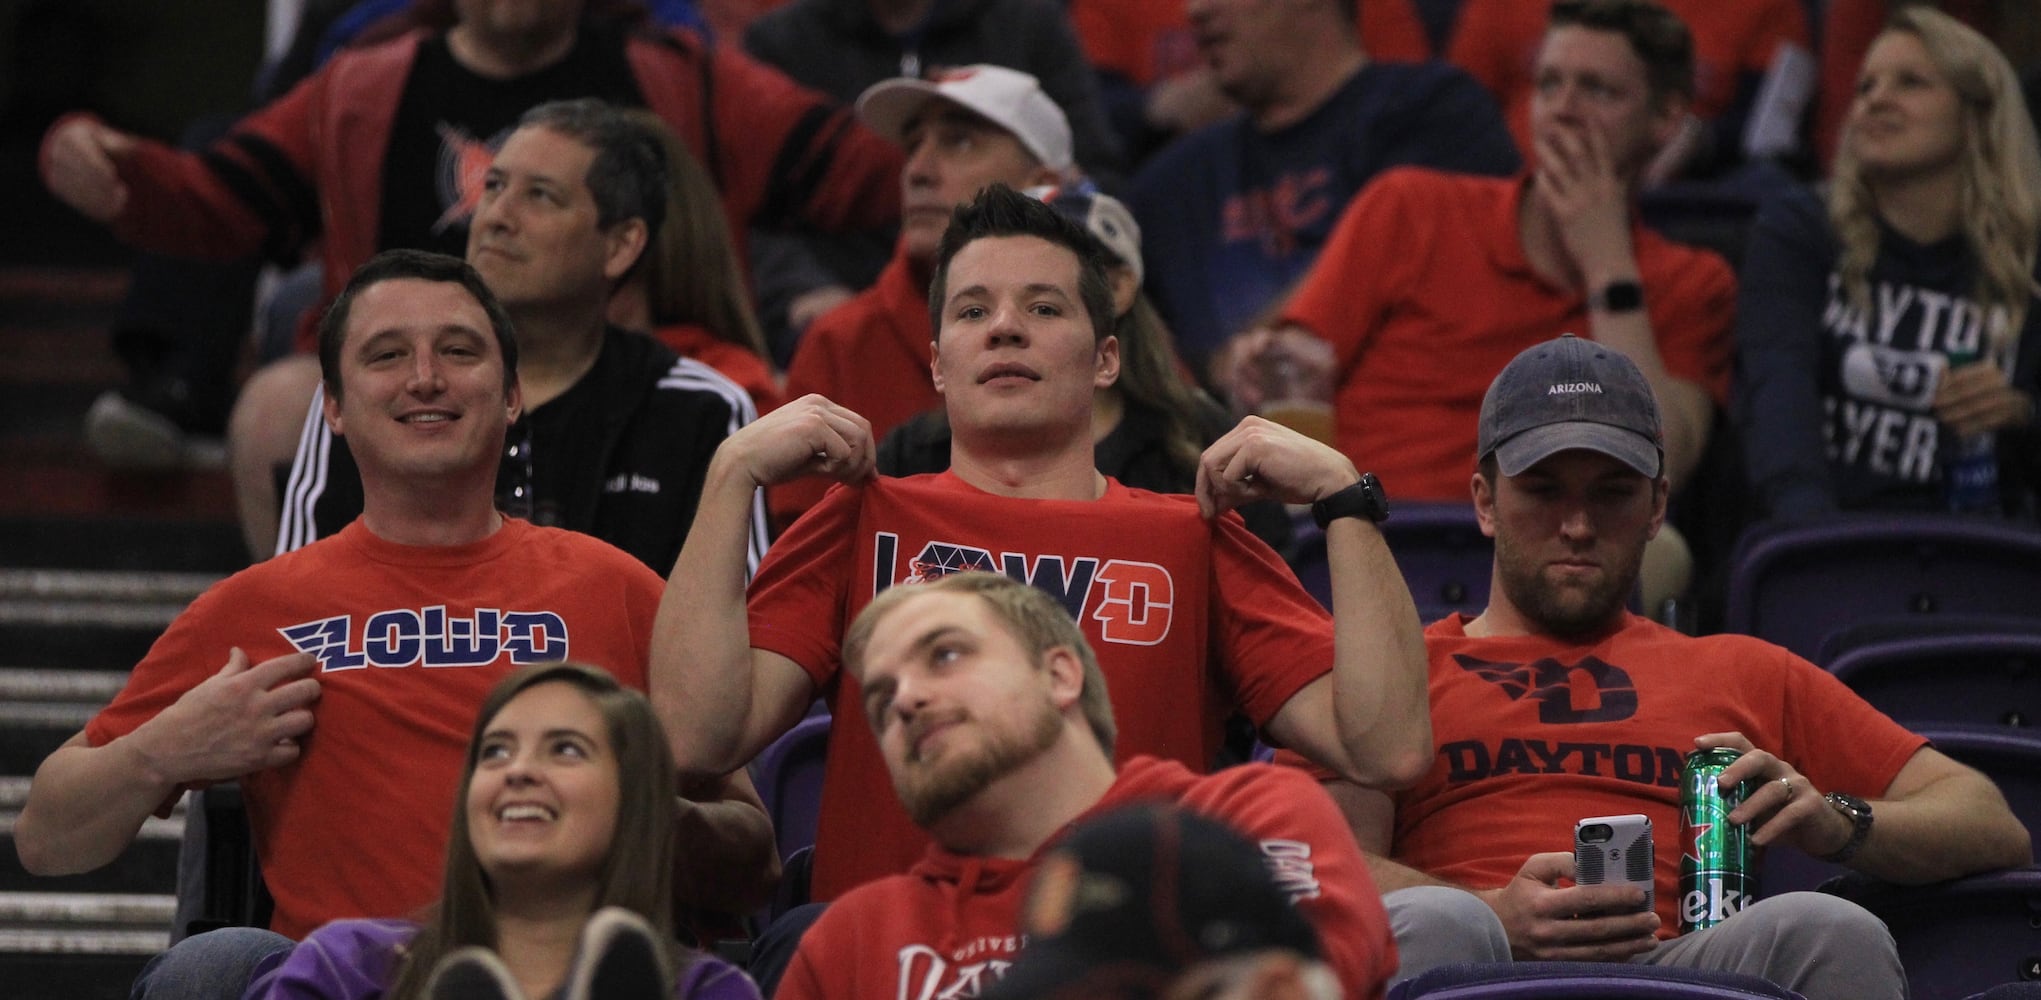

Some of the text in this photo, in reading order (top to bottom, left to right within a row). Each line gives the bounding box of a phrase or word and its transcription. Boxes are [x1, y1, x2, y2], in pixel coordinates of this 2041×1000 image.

[1548, 382, 1603, 395] ARIZONA
[276, 604, 569, 672] LOWD
[1440, 738, 1688, 788] DAYTON
